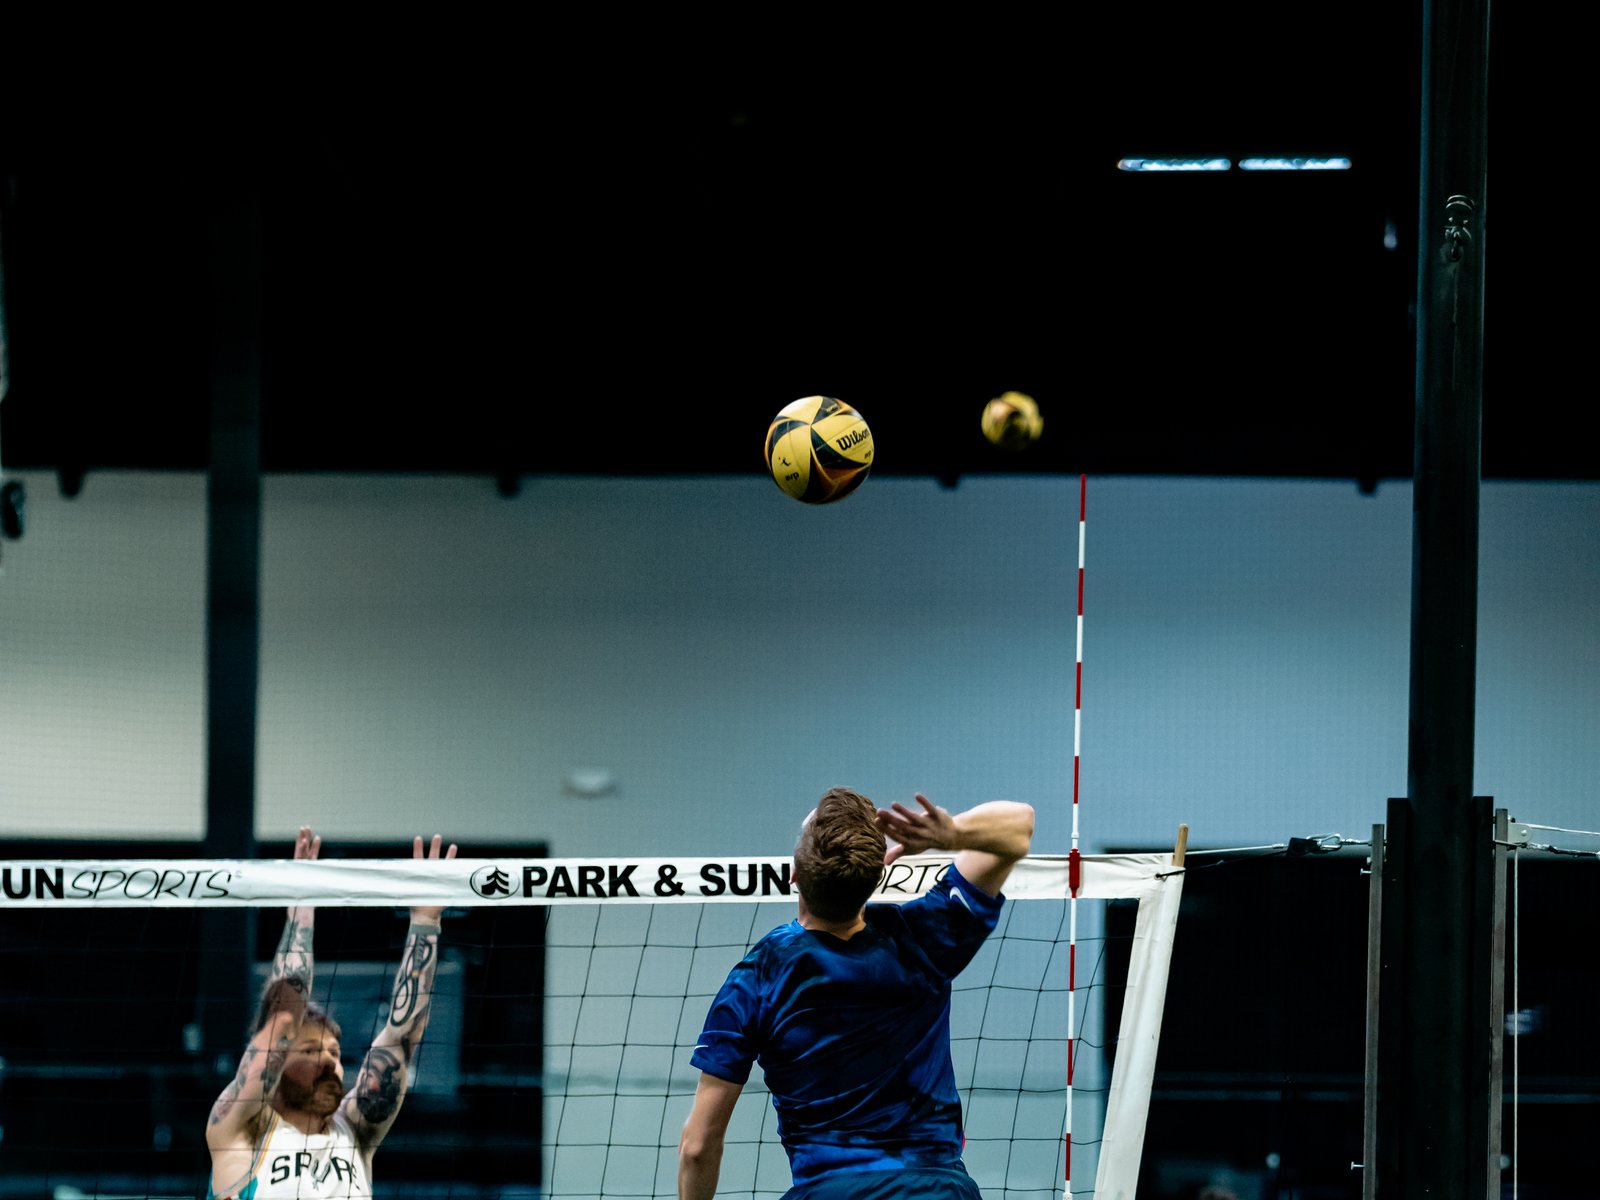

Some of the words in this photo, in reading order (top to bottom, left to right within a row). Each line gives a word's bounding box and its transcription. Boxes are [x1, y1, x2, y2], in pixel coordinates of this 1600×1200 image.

[836, 428, 870, 451] Wilson
[0, 868, 65, 899] UN
[66, 869, 232, 900] SPORTS
[522, 864, 640, 898] PARK
[653, 864, 686, 897] &
[699, 863, 792, 897] SUN
